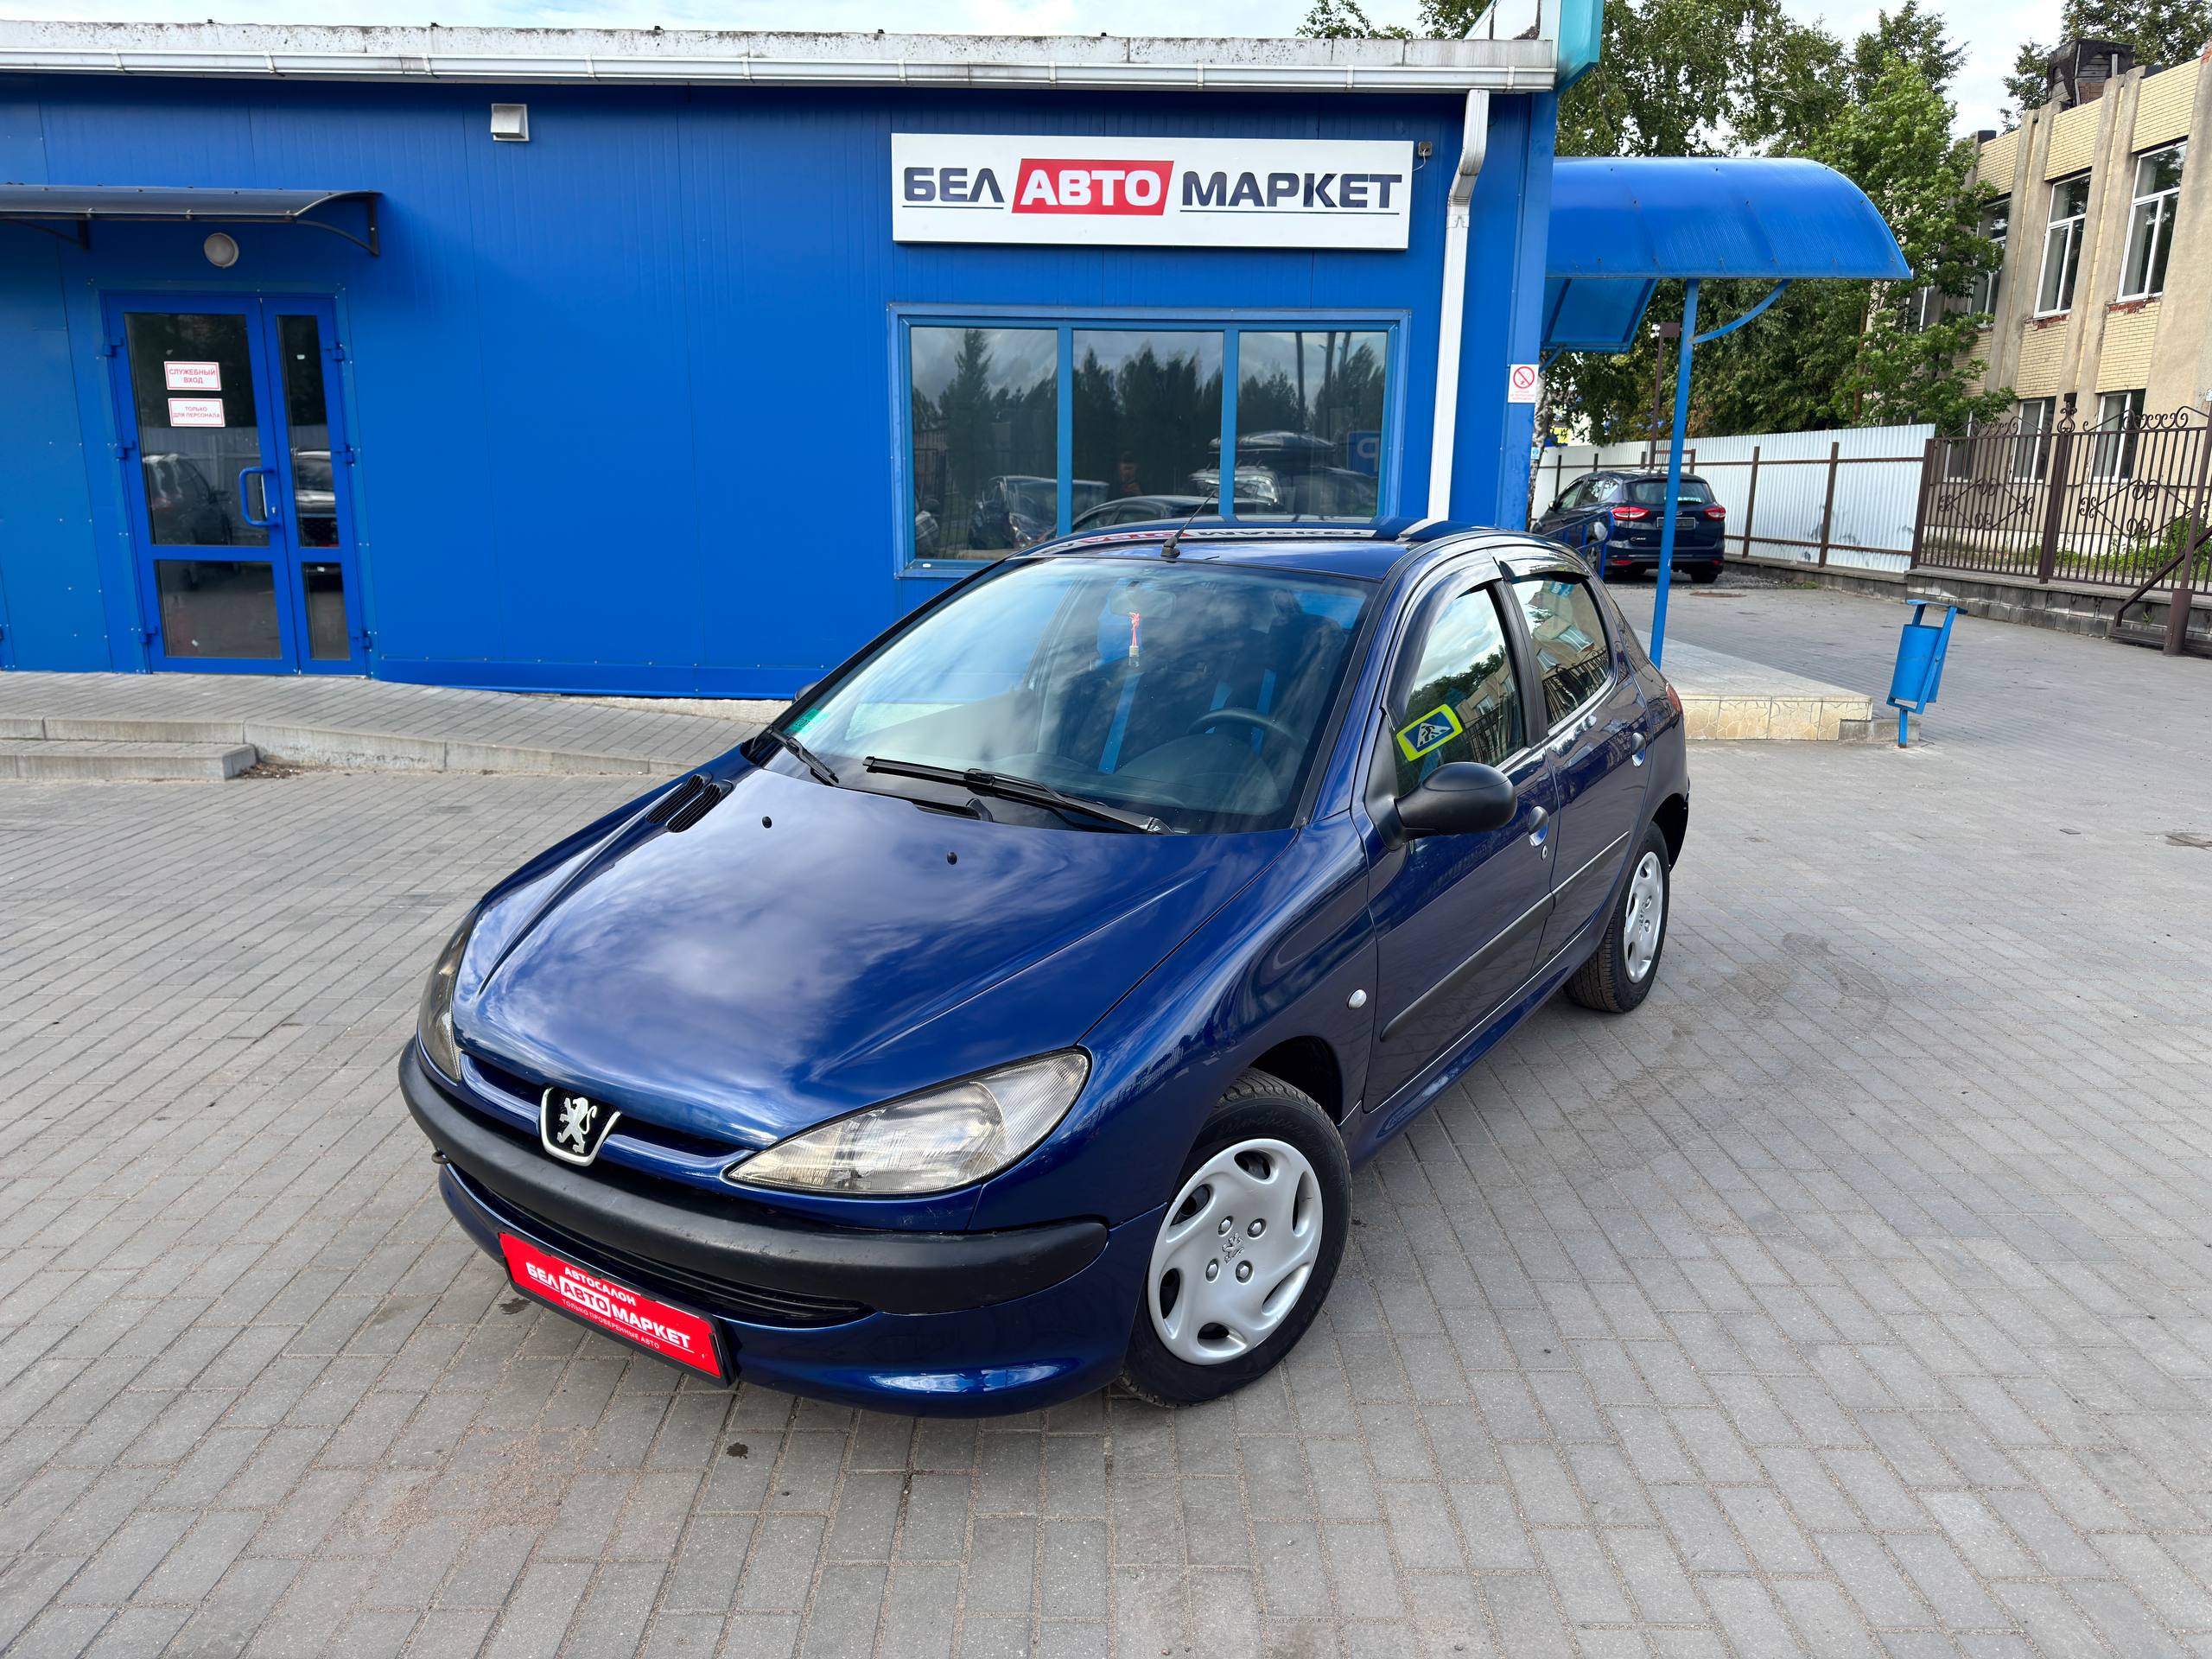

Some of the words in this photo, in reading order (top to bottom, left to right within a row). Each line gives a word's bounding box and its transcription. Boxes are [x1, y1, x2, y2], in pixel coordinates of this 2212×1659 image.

[904, 167, 1004, 203] БЕЛ
[1020, 168, 1162, 206] АВТО
[1182, 170, 1402, 209] МАРКЕТ
[525, 1262, 559, 1290] БЕЛ
[561, 1283, 608, 1313] АВТО
[610, 1304, 690, 1349] МАРКЕТ
[564, 1267, 636, 1306] АВТОСАЛОН
[562, 1299, 588, 1316] ТОЛЬКО
[589, 1311, 639, 1340] ПРОВЕРЕННЫЕ
[641, 1336, 660, 1349] АВТО
